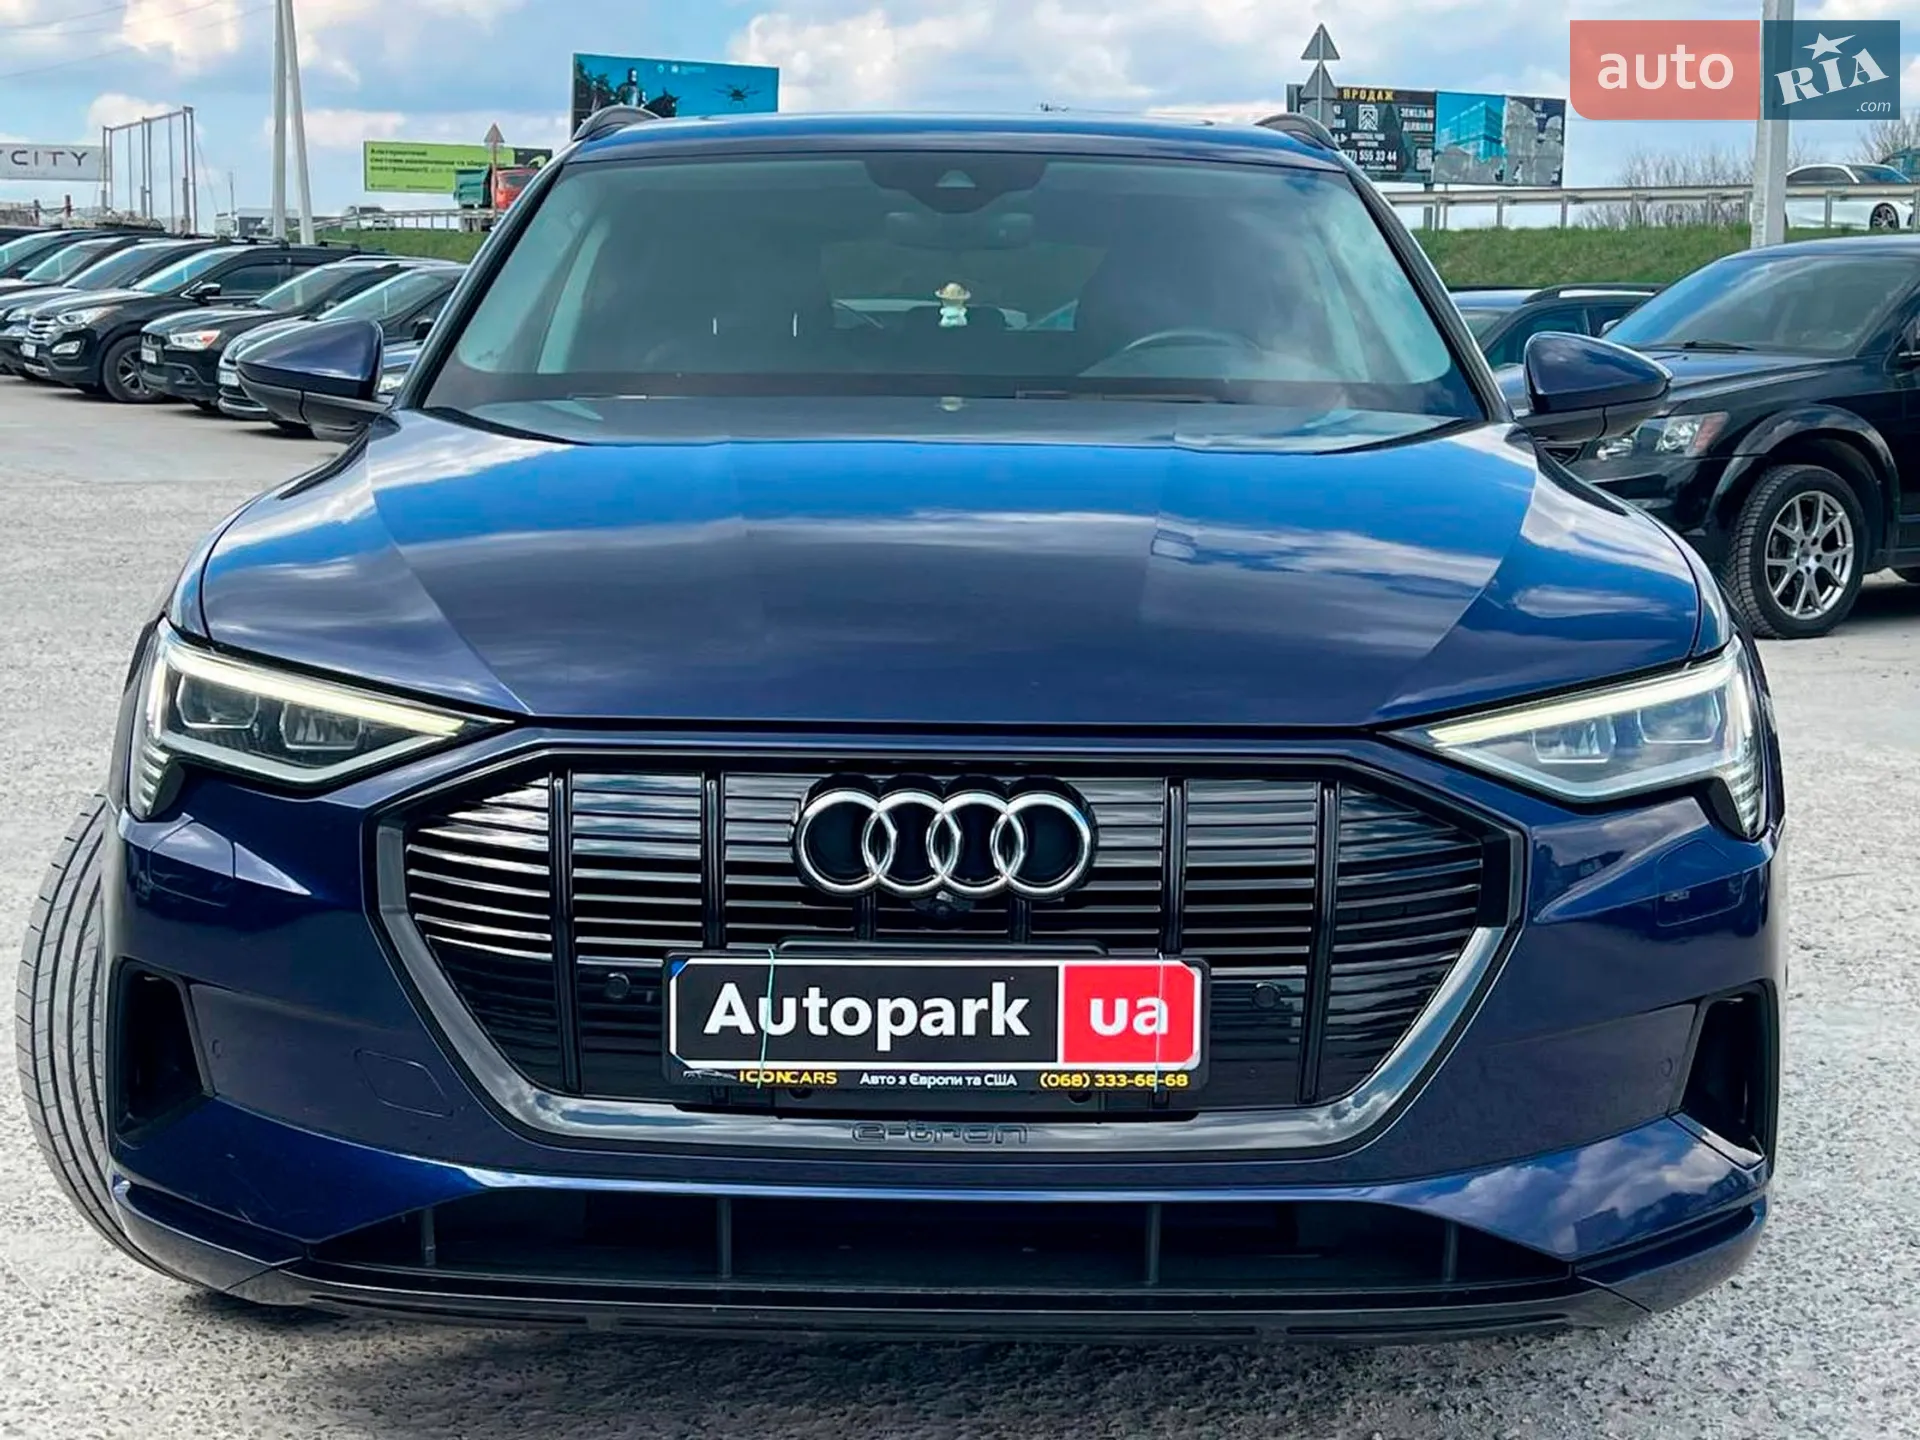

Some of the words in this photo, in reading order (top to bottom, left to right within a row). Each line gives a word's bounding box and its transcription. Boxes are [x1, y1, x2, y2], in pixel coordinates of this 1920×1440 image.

[1343, 89, 1394, 102] ПРОДАЖ
[0, 150, 88, 166] CITY
[703, 981, 1030, 1051] Autopark
[1088, 996, 1170, 1036] ua
[860, 1073, 896, 1086] Авто
[909, 1073, 961, 1089] Європи
[965, 1076, 981, 1086] та
[984, 1073, 1017, 1086] США
[1040, 1073, 1090, 1088] (068)
[1094, 1074, 1189, 1087] 333-68-68
[852, 1119, 1028, 1144] e-tron
